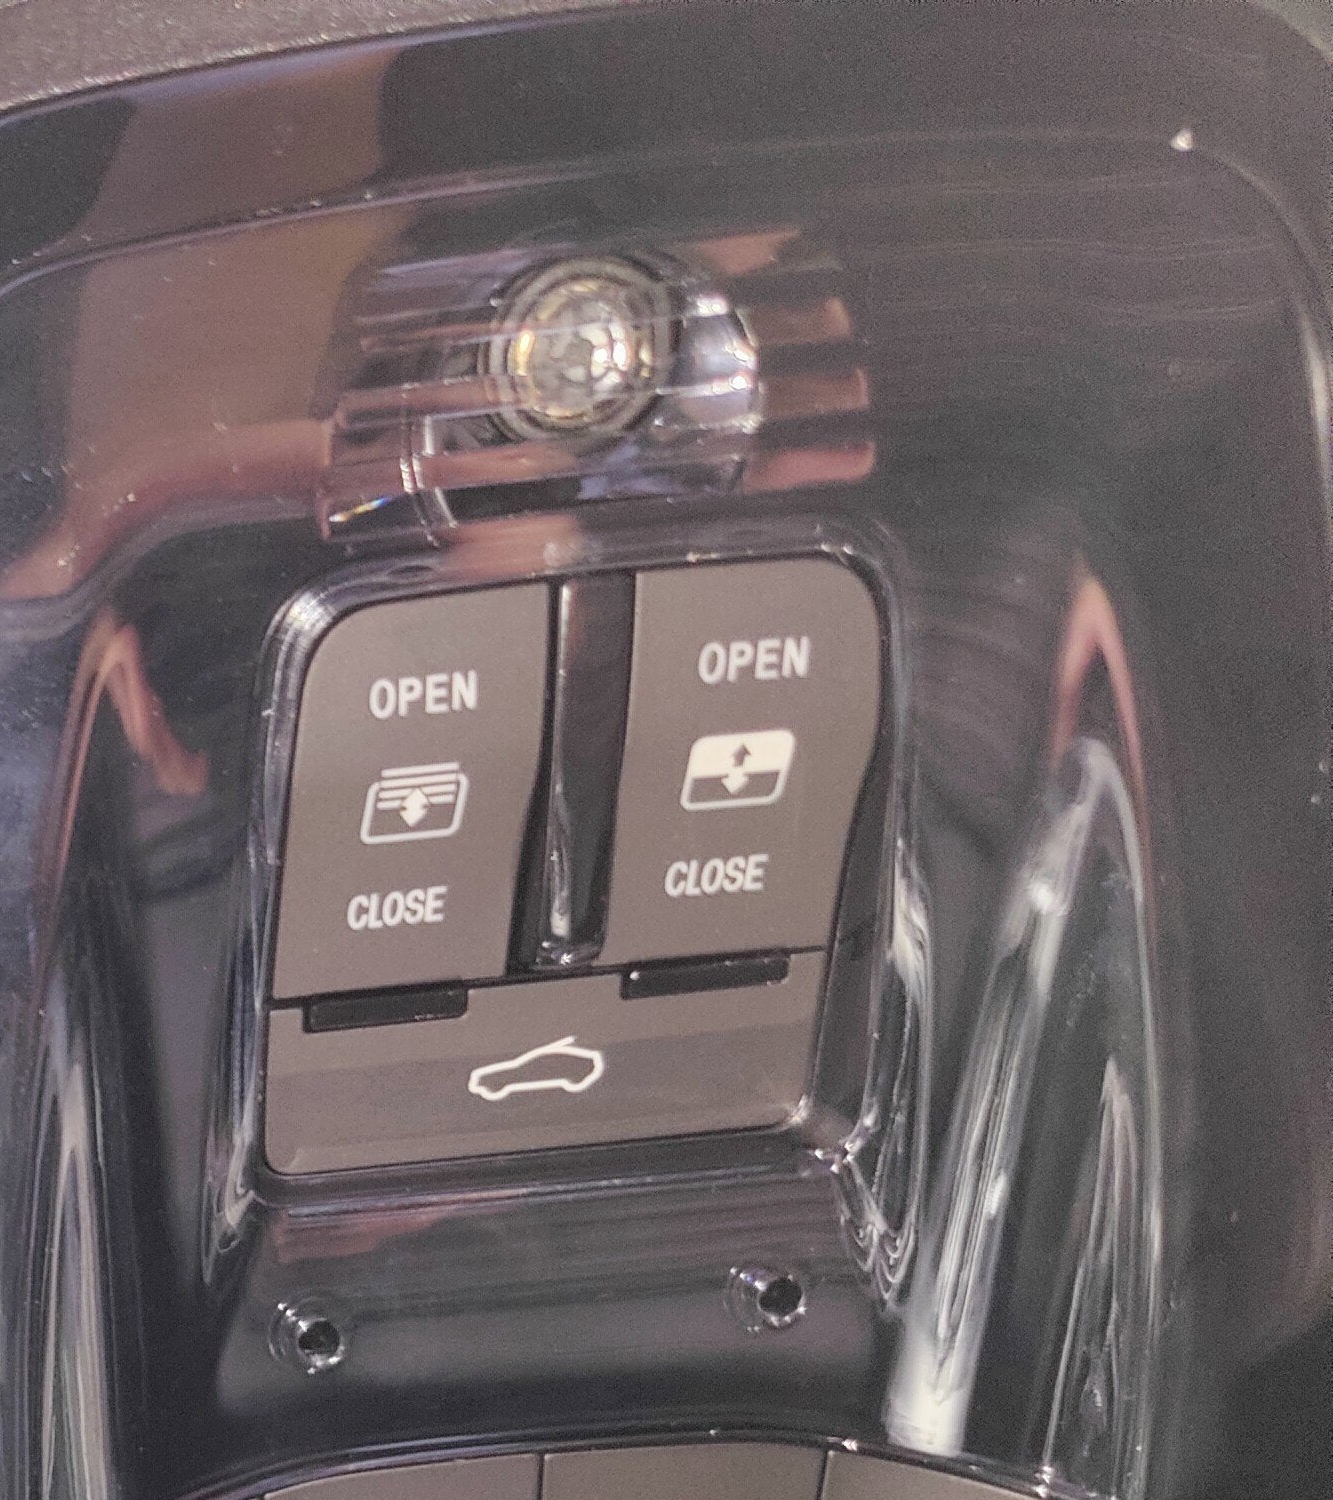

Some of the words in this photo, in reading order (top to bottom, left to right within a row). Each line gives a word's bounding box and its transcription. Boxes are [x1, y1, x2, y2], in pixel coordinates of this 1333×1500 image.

[697, 636, 810, 684] OPEN
[369, 670, 478, 719] OPEN
[664, 853, 769, 898] CLOSE
[347, 886, 447, 931] CLOSE
